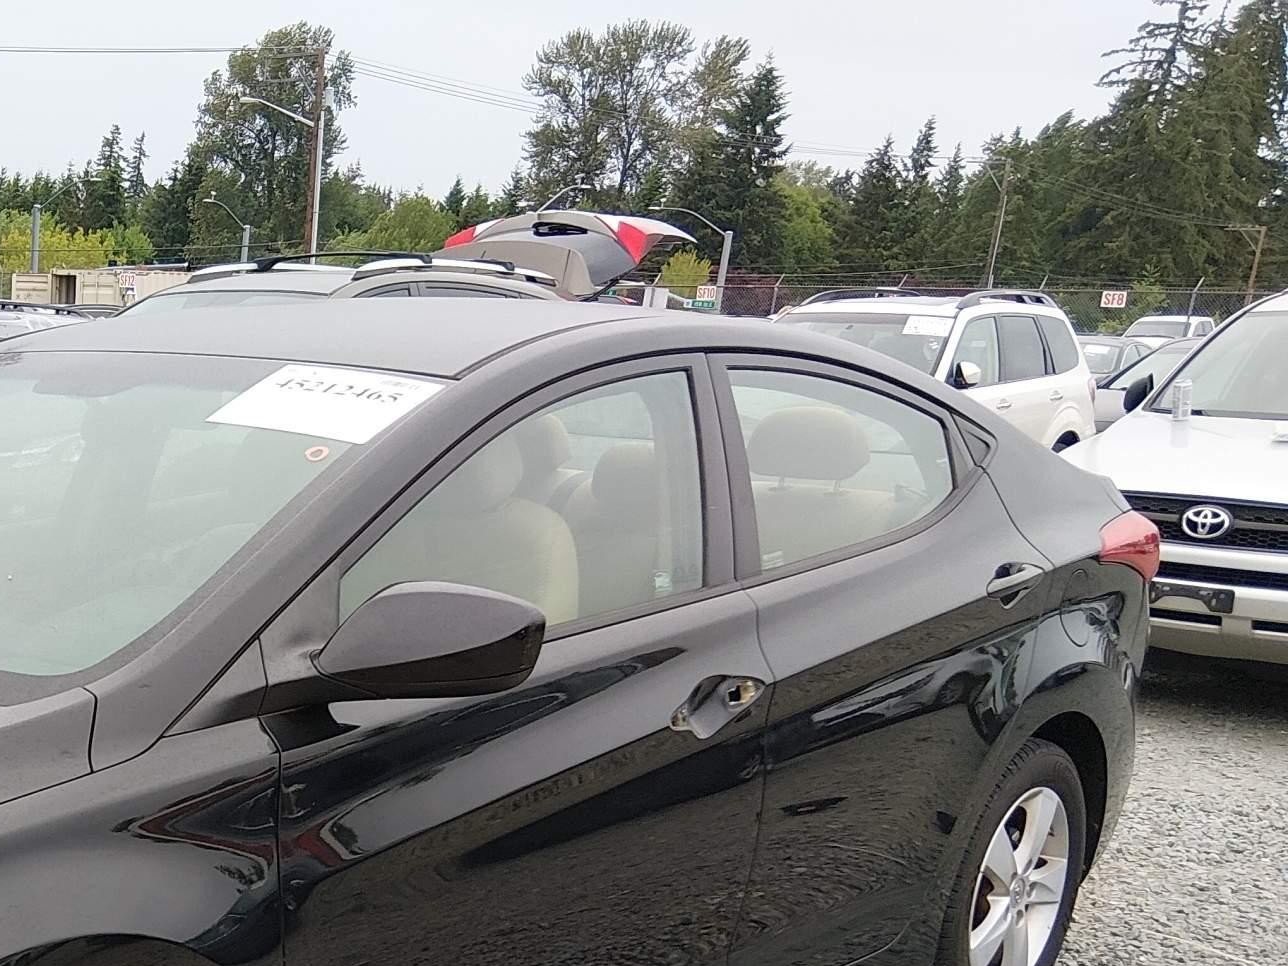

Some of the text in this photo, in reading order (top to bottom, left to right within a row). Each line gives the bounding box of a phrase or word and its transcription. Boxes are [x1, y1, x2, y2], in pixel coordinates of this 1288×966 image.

[120, 274, 135, 286] SF12
[697, 287, 716, 299] SF10
[1103, 293, 1124, 306] SF8
[276, 378, 403, 402] 45212465
